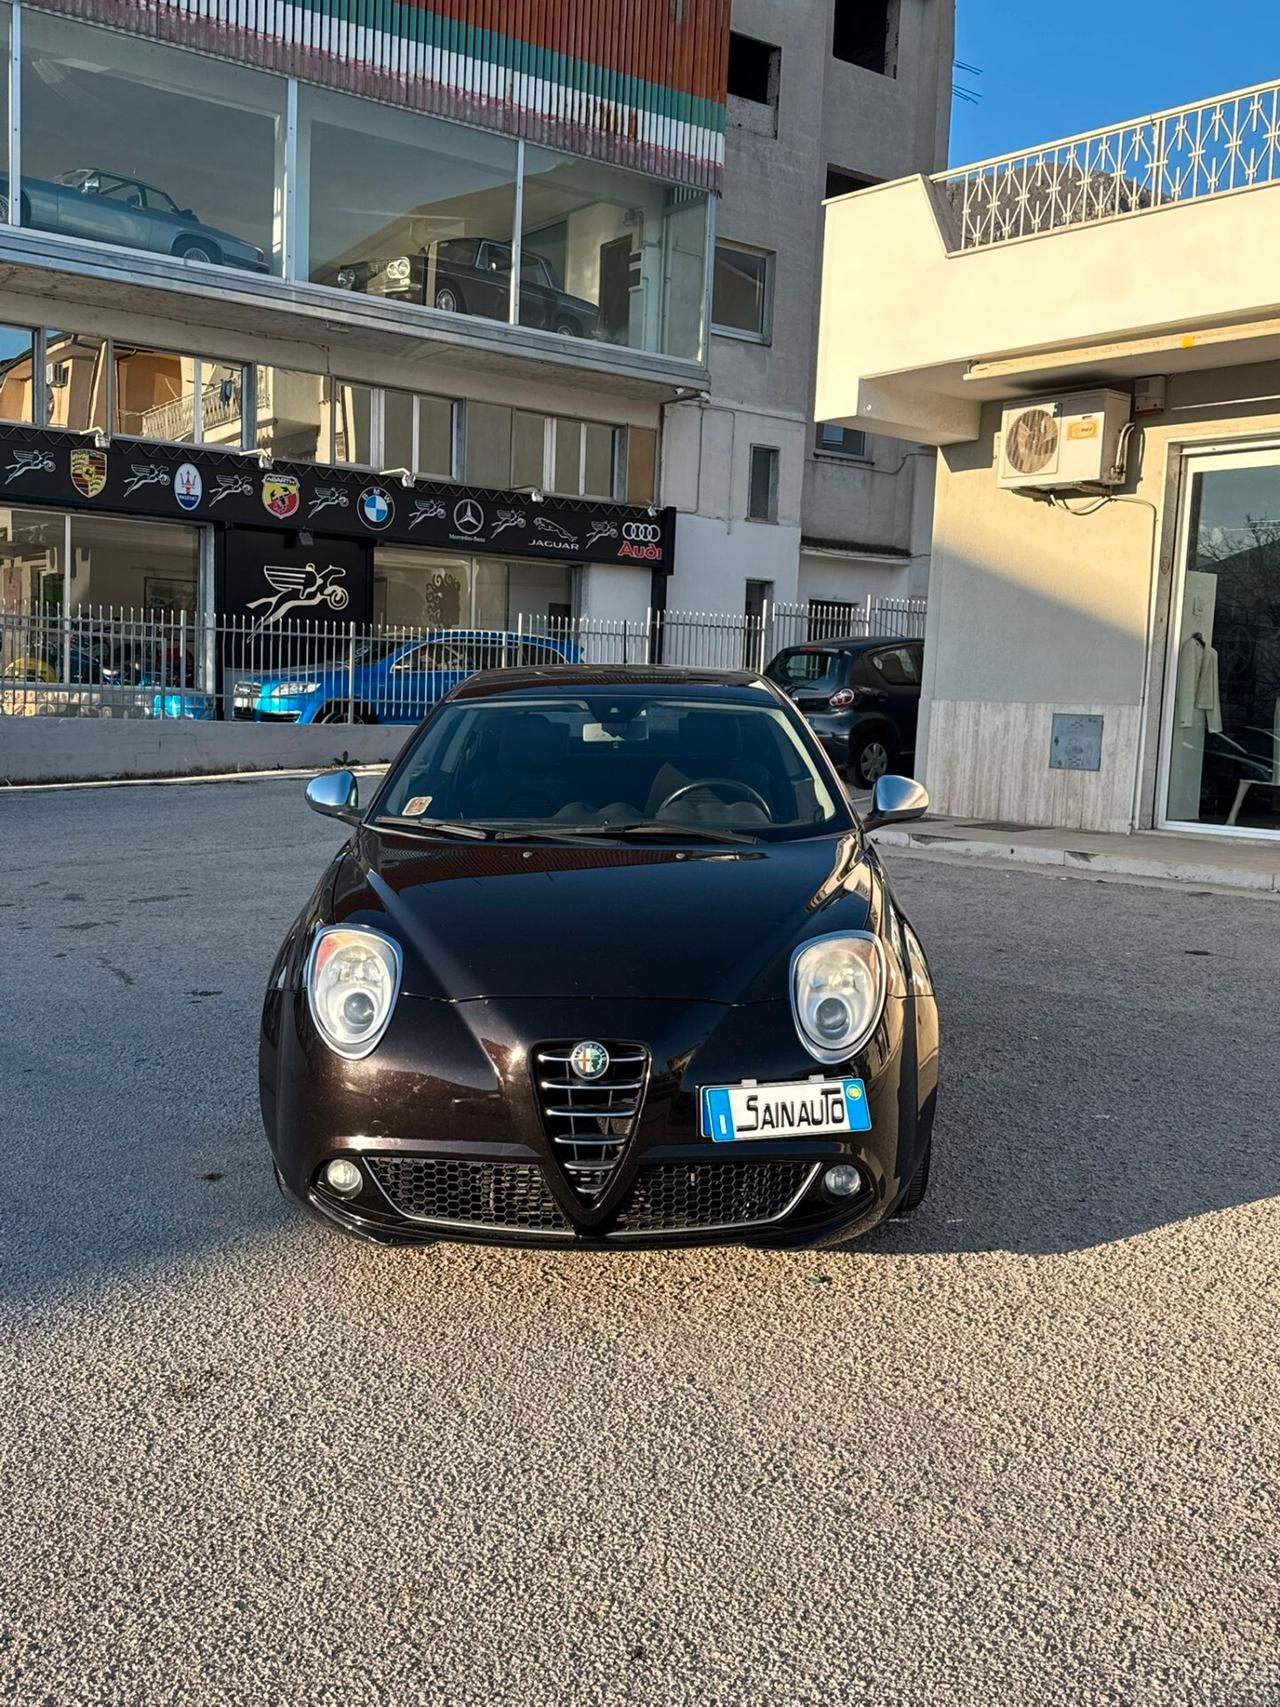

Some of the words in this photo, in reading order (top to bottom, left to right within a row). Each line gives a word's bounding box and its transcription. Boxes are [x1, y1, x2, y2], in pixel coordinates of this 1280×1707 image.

[361, 488, 392, 504] BMW
[528, 539, 579, 551] JAGUAR
[617, 540, 663, 560] Audi
[736, 1088, 845, 1132] SAINAUTO
